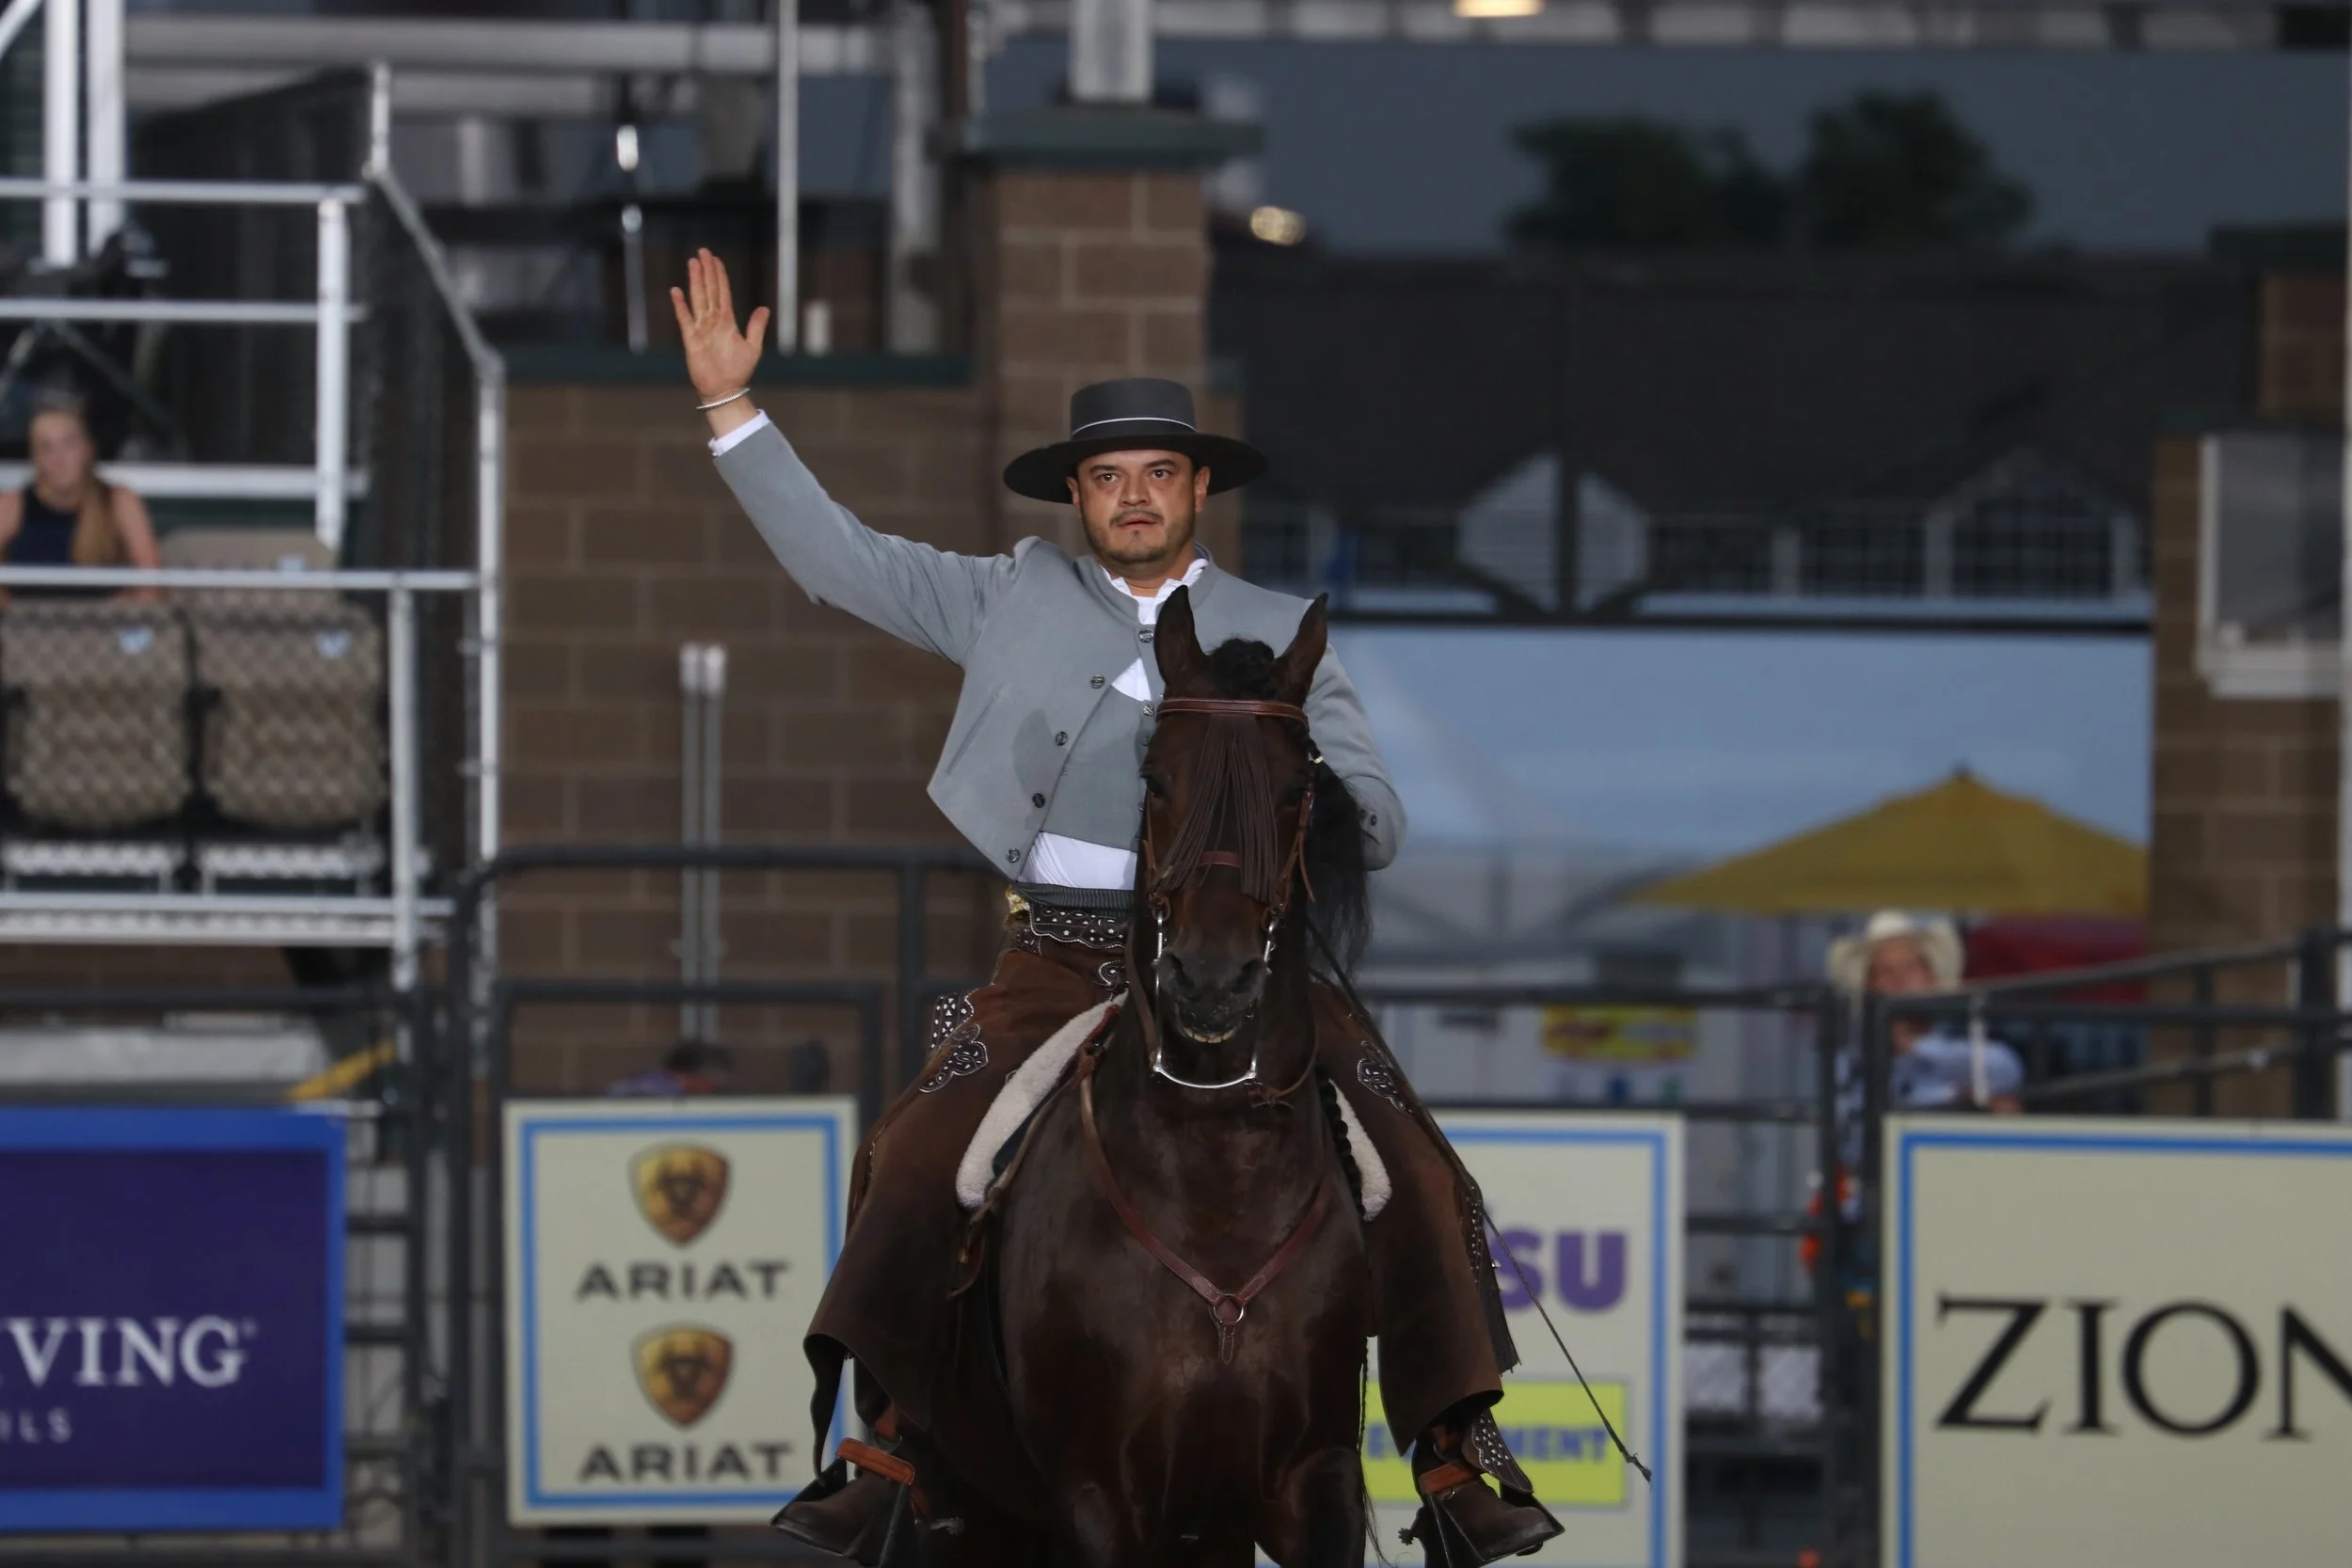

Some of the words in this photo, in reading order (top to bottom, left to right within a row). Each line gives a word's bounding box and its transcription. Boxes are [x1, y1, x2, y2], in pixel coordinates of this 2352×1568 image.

[575, 1259, 790, 1303] ARIAT
[1486, 1205, 1628, 1313] SU
[1932, 1290, 2352, 1440] ZION
[577, 1442, 793, 1483] ARIAT
